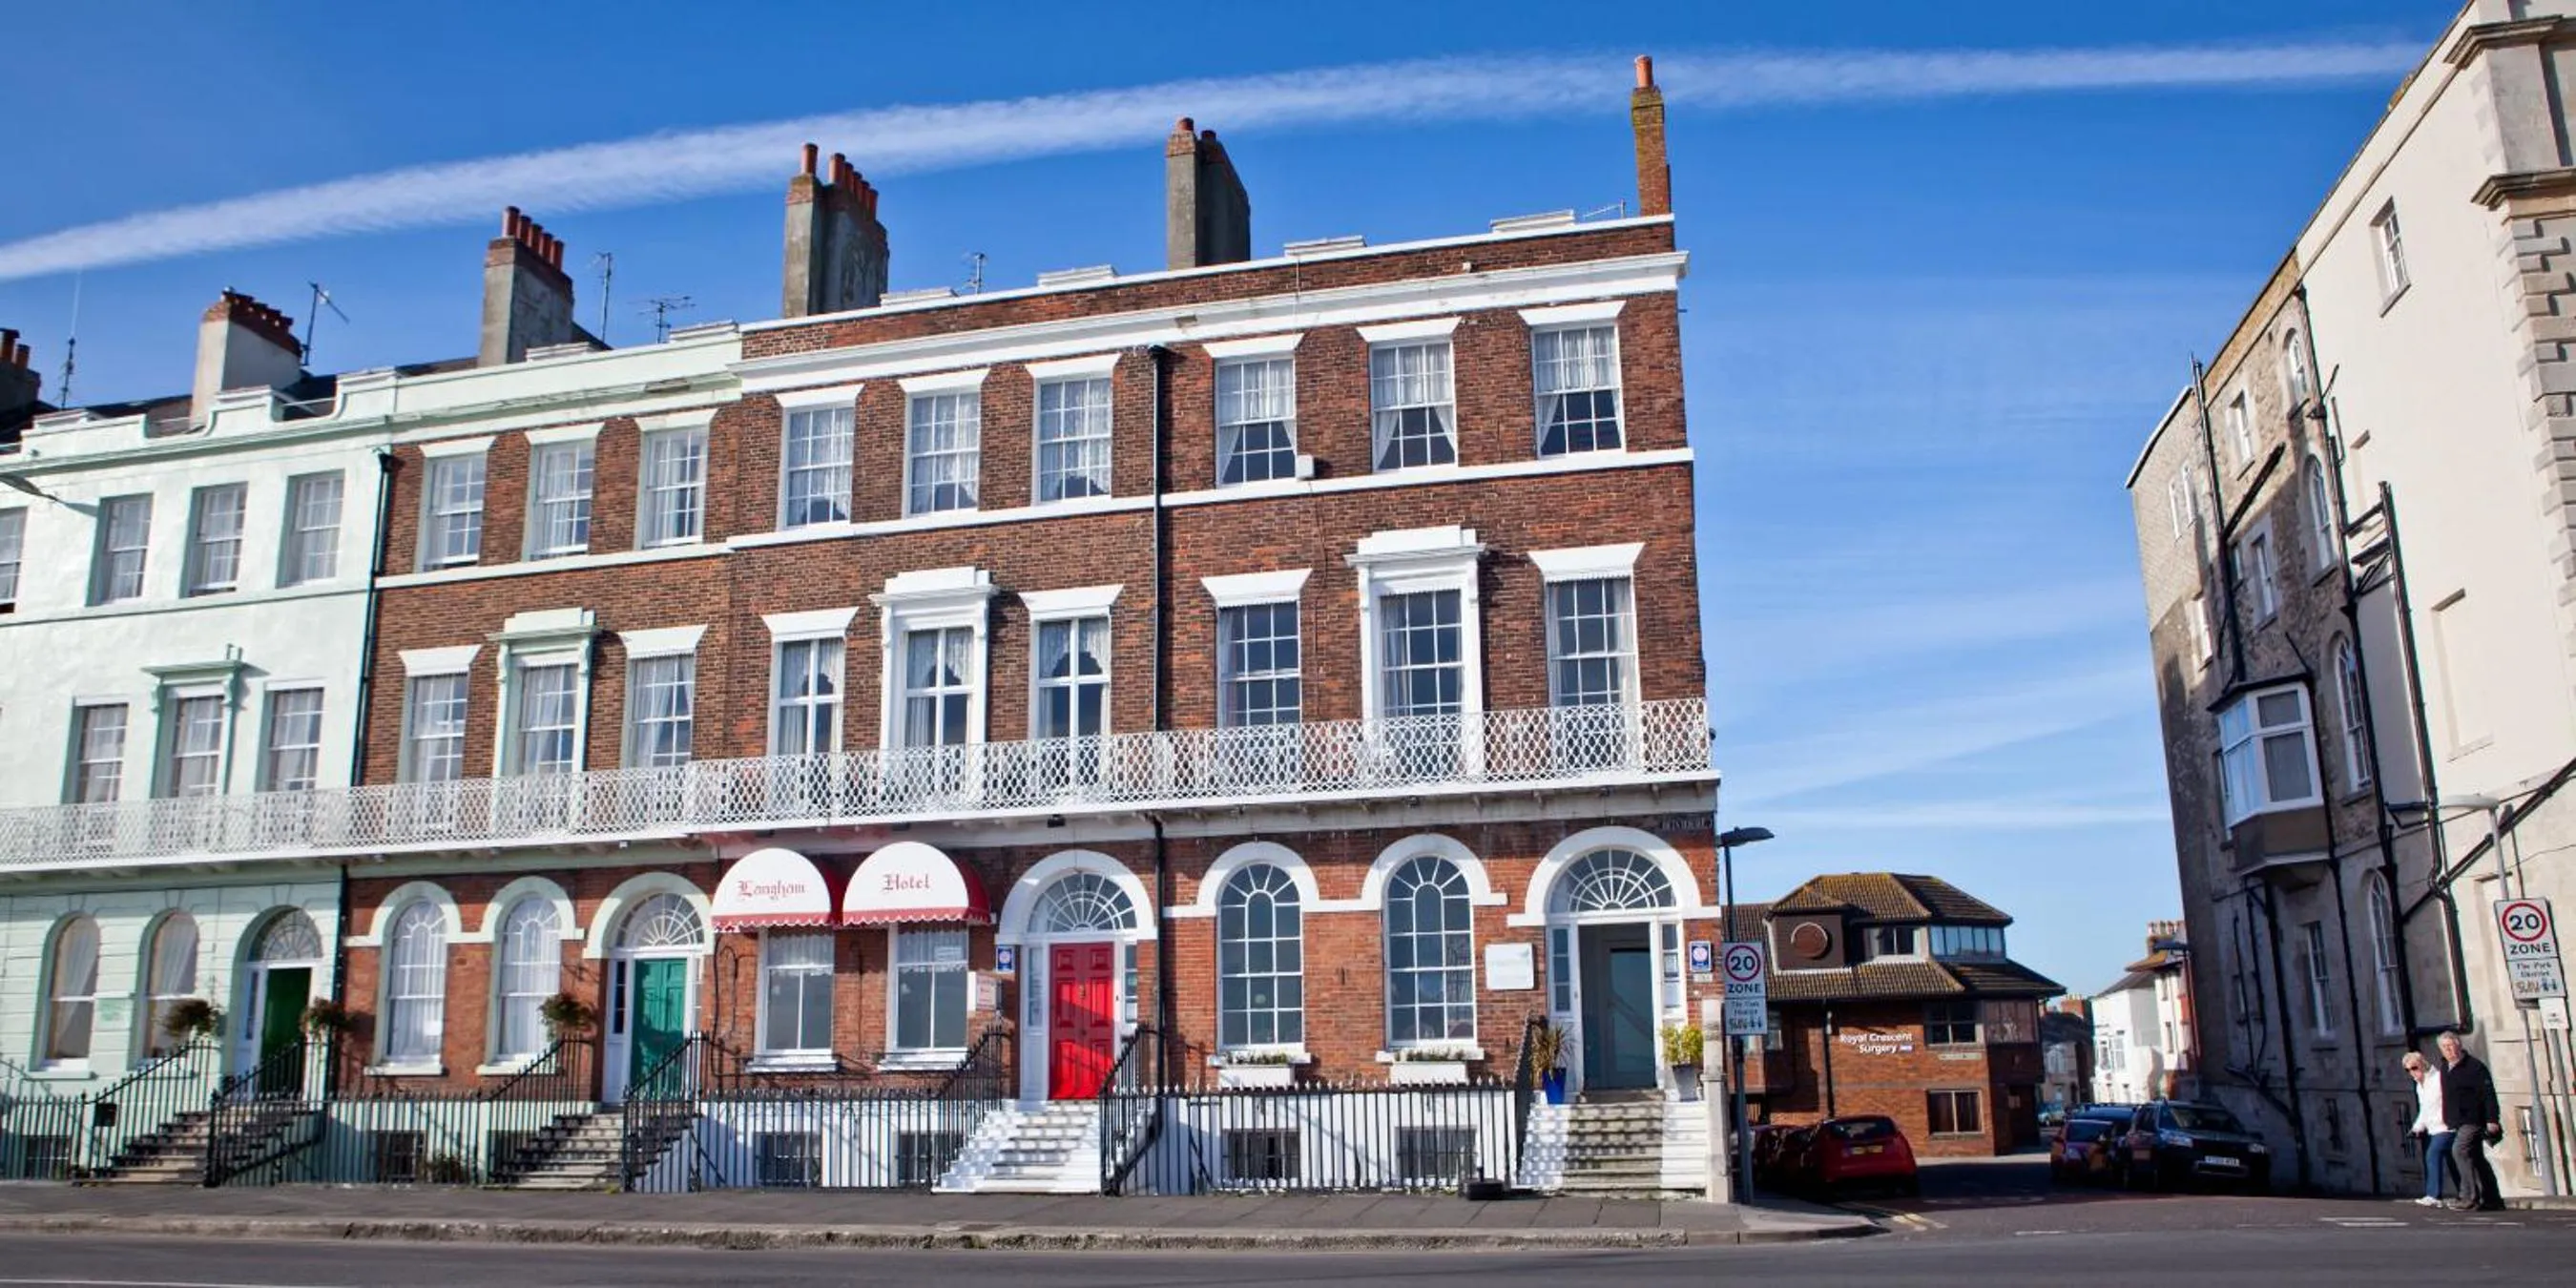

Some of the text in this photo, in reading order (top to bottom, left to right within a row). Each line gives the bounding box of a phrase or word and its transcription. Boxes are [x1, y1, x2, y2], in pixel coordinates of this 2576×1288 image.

[737, 881, 806, 900] Langham
[883, 873, 930, 893] Hotel
[2509, 914, 2540, 930] 20
[2509, 943, 2551, 955] ZONE
[1730, 955, 1756, 971] 20
[1727, 983, 1761, 993] ZONE
[1839, 1032, 1913, 1046] Royal Crescent
[1859, 1044, 1897, 1055] Surgery
